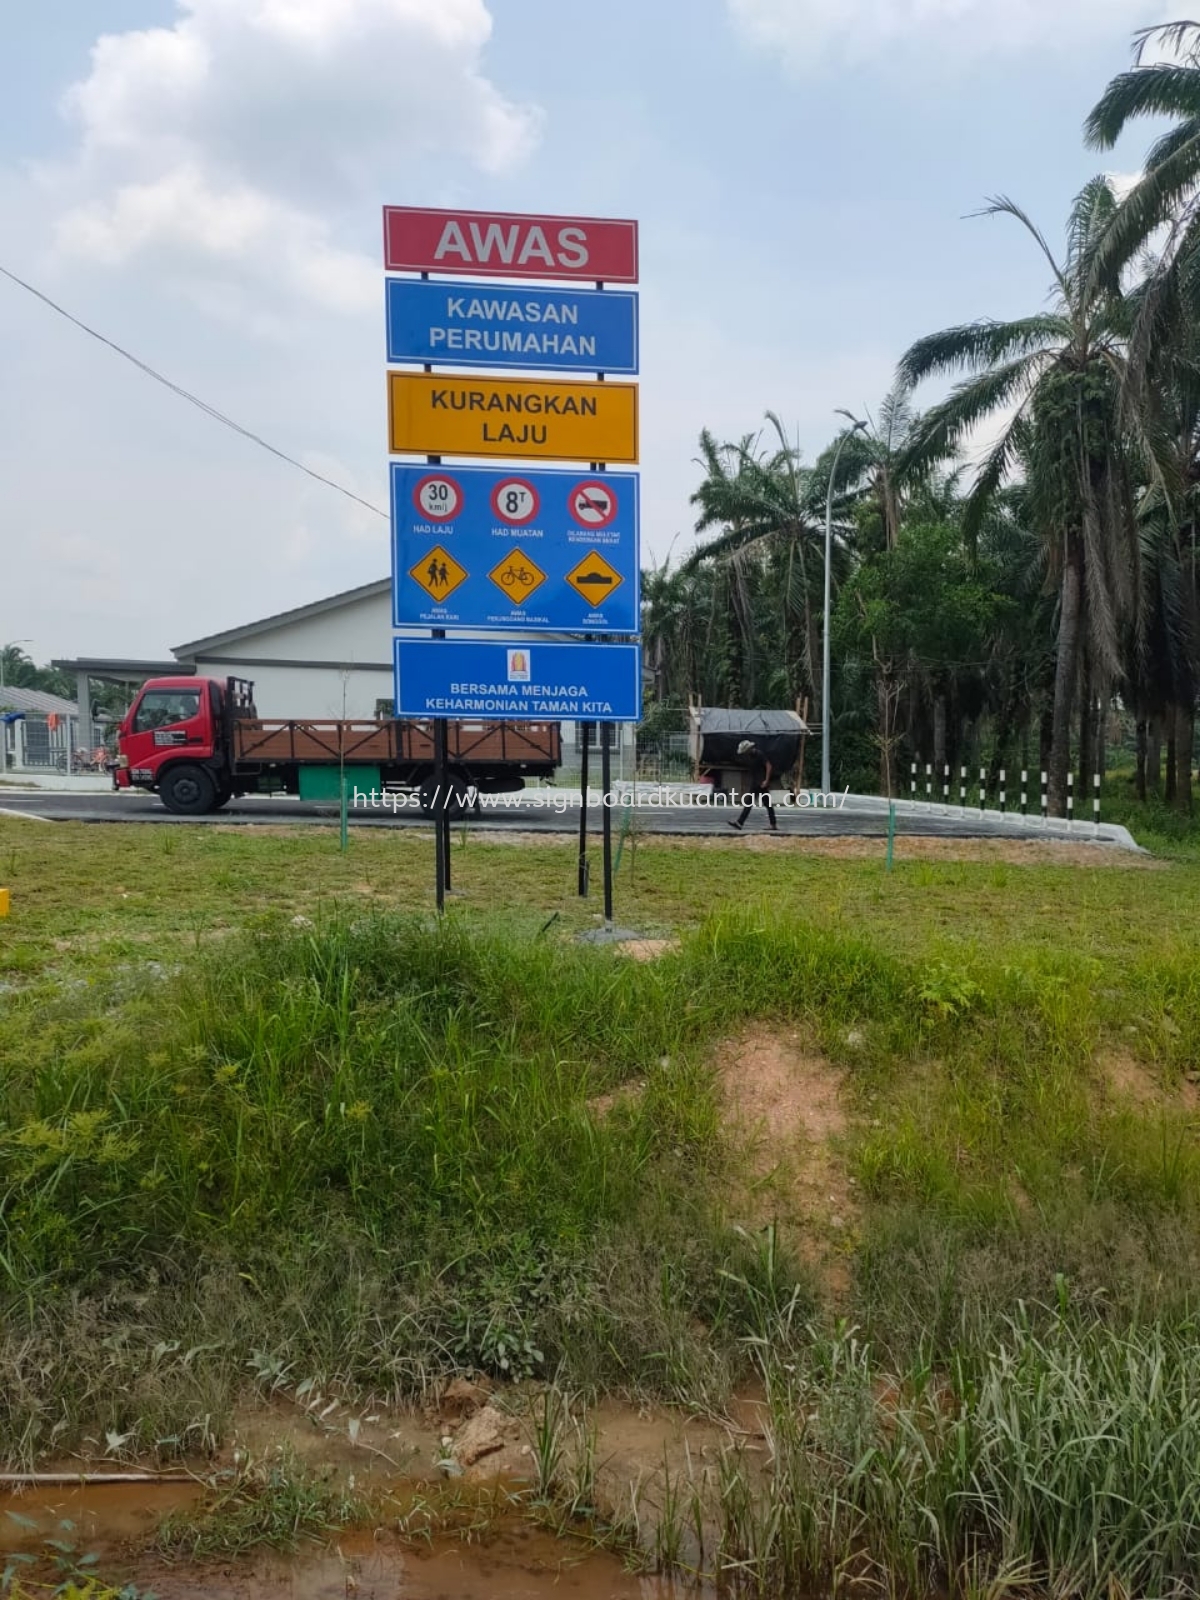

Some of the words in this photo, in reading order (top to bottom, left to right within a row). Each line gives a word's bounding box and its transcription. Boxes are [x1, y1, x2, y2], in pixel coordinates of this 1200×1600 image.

[434, 221, 589, 268] AWAS
[447, 298, 578, 324] KAWASAN
[429, 327, 596, 356] PERUMAHAN
[431, 390, 597, 415] KURANGKAN
[482, 423, 547, 444] LAJU
[428, 484, 448, 501] 30
[413, 524, 431, 534] HAD
[432, 525, 453, 536] LAJU
[491, 527, 509, 537] HAD
[510, 528, 544, 539] MUATAN
[450, 683, 517, 696] BERSAMA
[522, 685, 588, 697] MENJAGA
[425, 698, 528, 711] KEHARMONIAN
[531, 700, 578, 712] TAMAN
[582, 701, 612, 713] KITA
